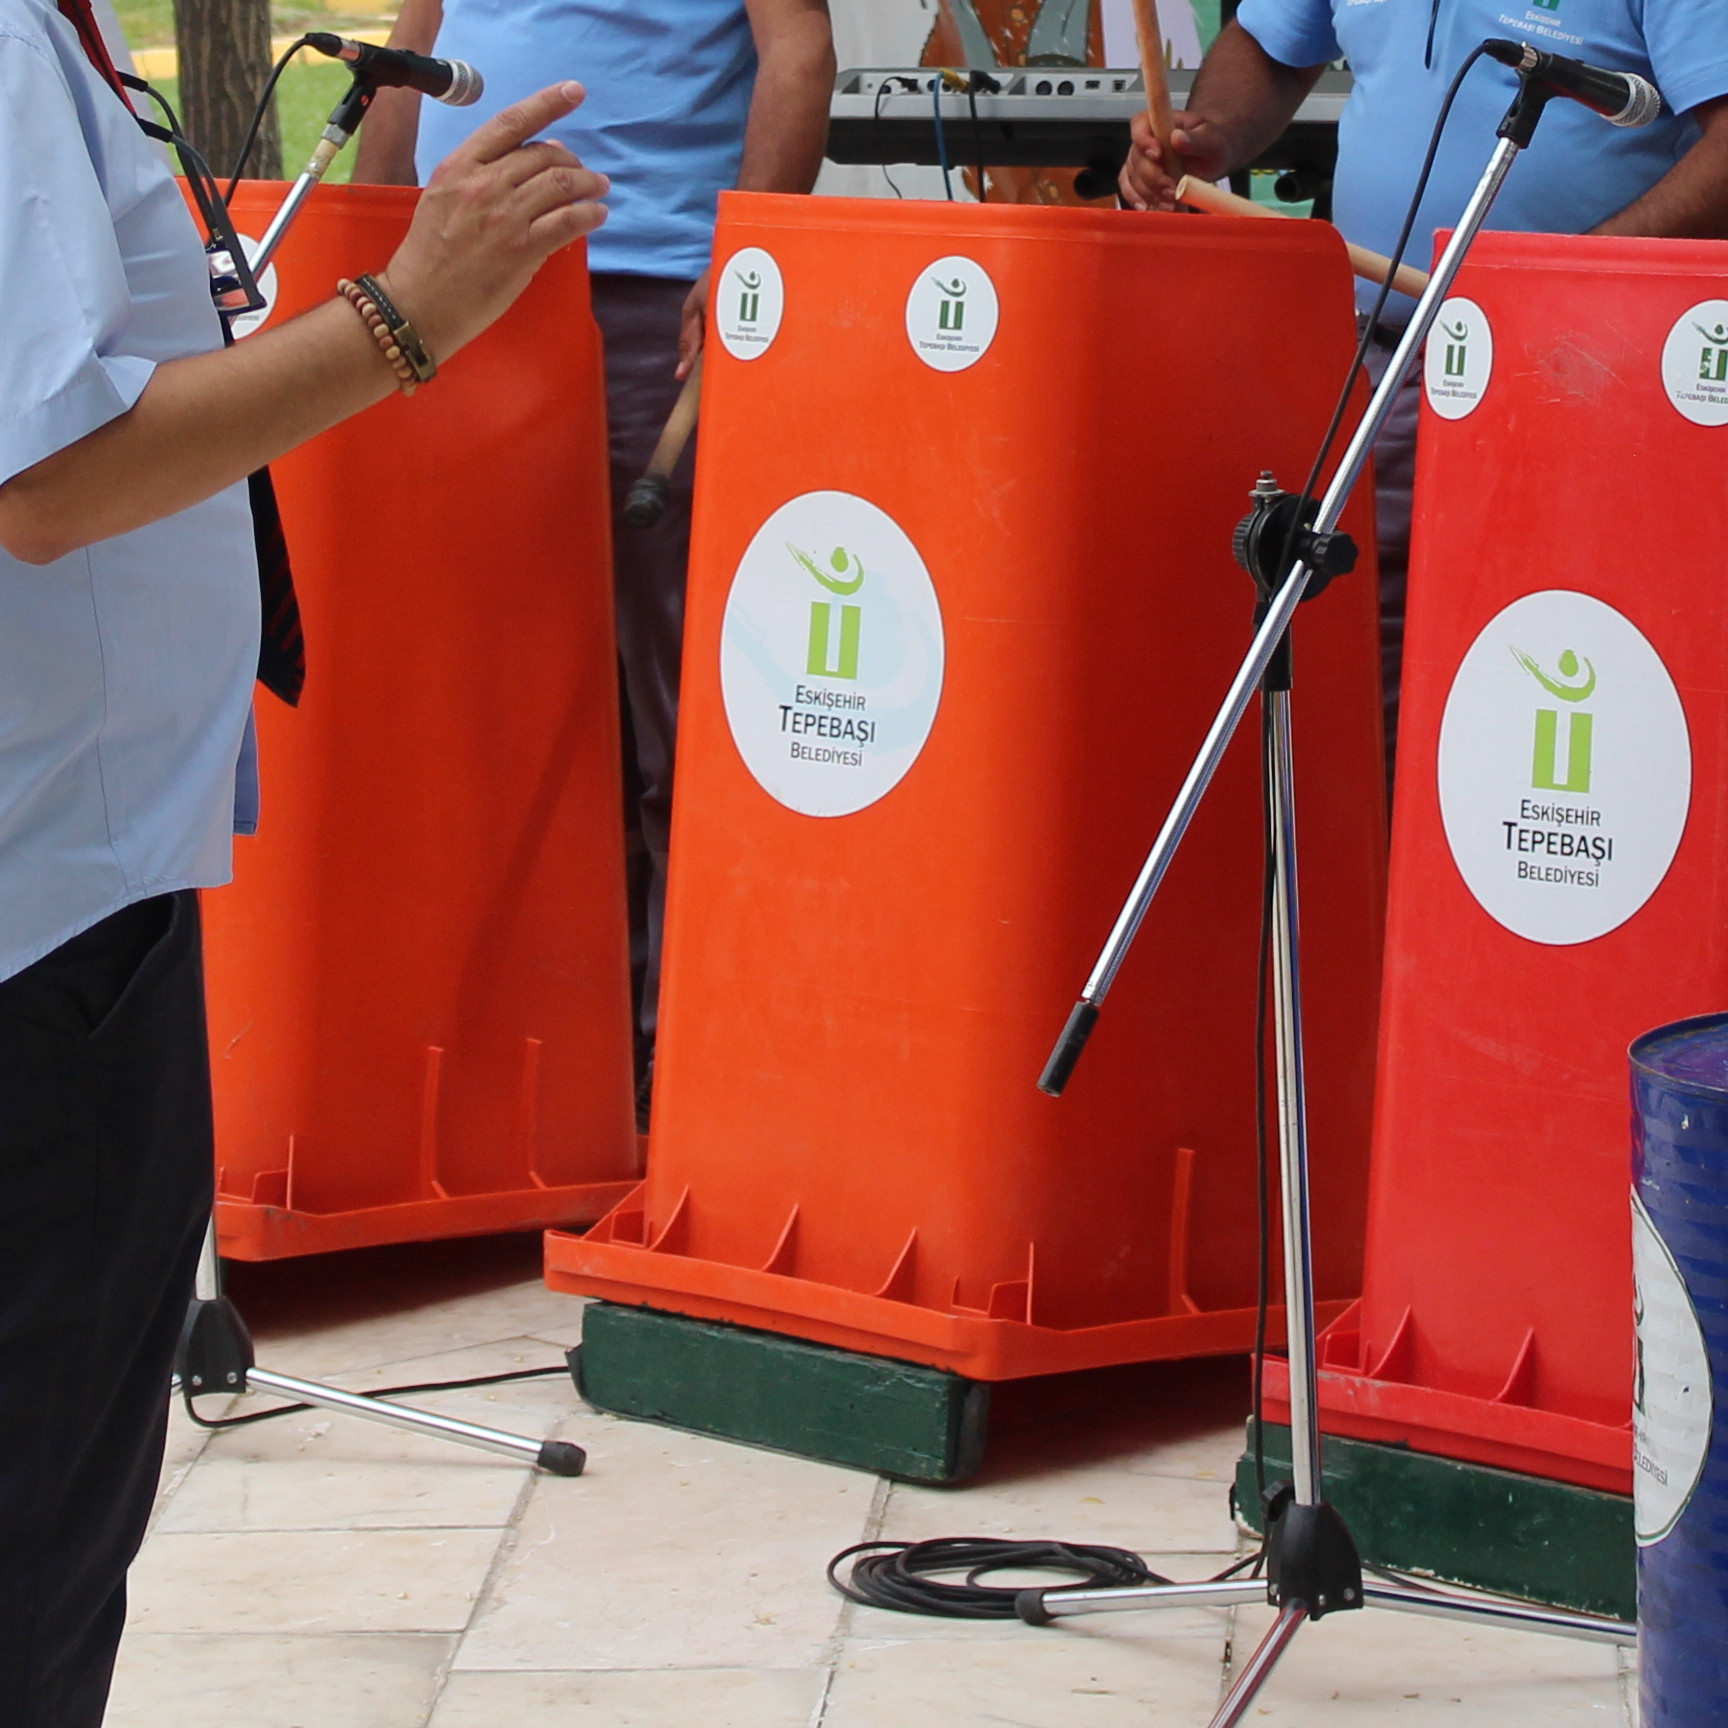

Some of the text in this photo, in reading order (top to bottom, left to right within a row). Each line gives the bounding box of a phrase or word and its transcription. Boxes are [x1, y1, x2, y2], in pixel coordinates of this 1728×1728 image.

[794, 684, 867, 712] ESKİŞEHİR
[779, 705, 876, 748] TEPEBAŞI
[790, 741, 864, 767] BELEDİYESİ
[1520, 799, 1602, 827] ESKİŞEHİR
[1502, 821, 1614, 867] TEPEBAŞI
[1517, 860, 1600, 888] BELEDİYESİ
